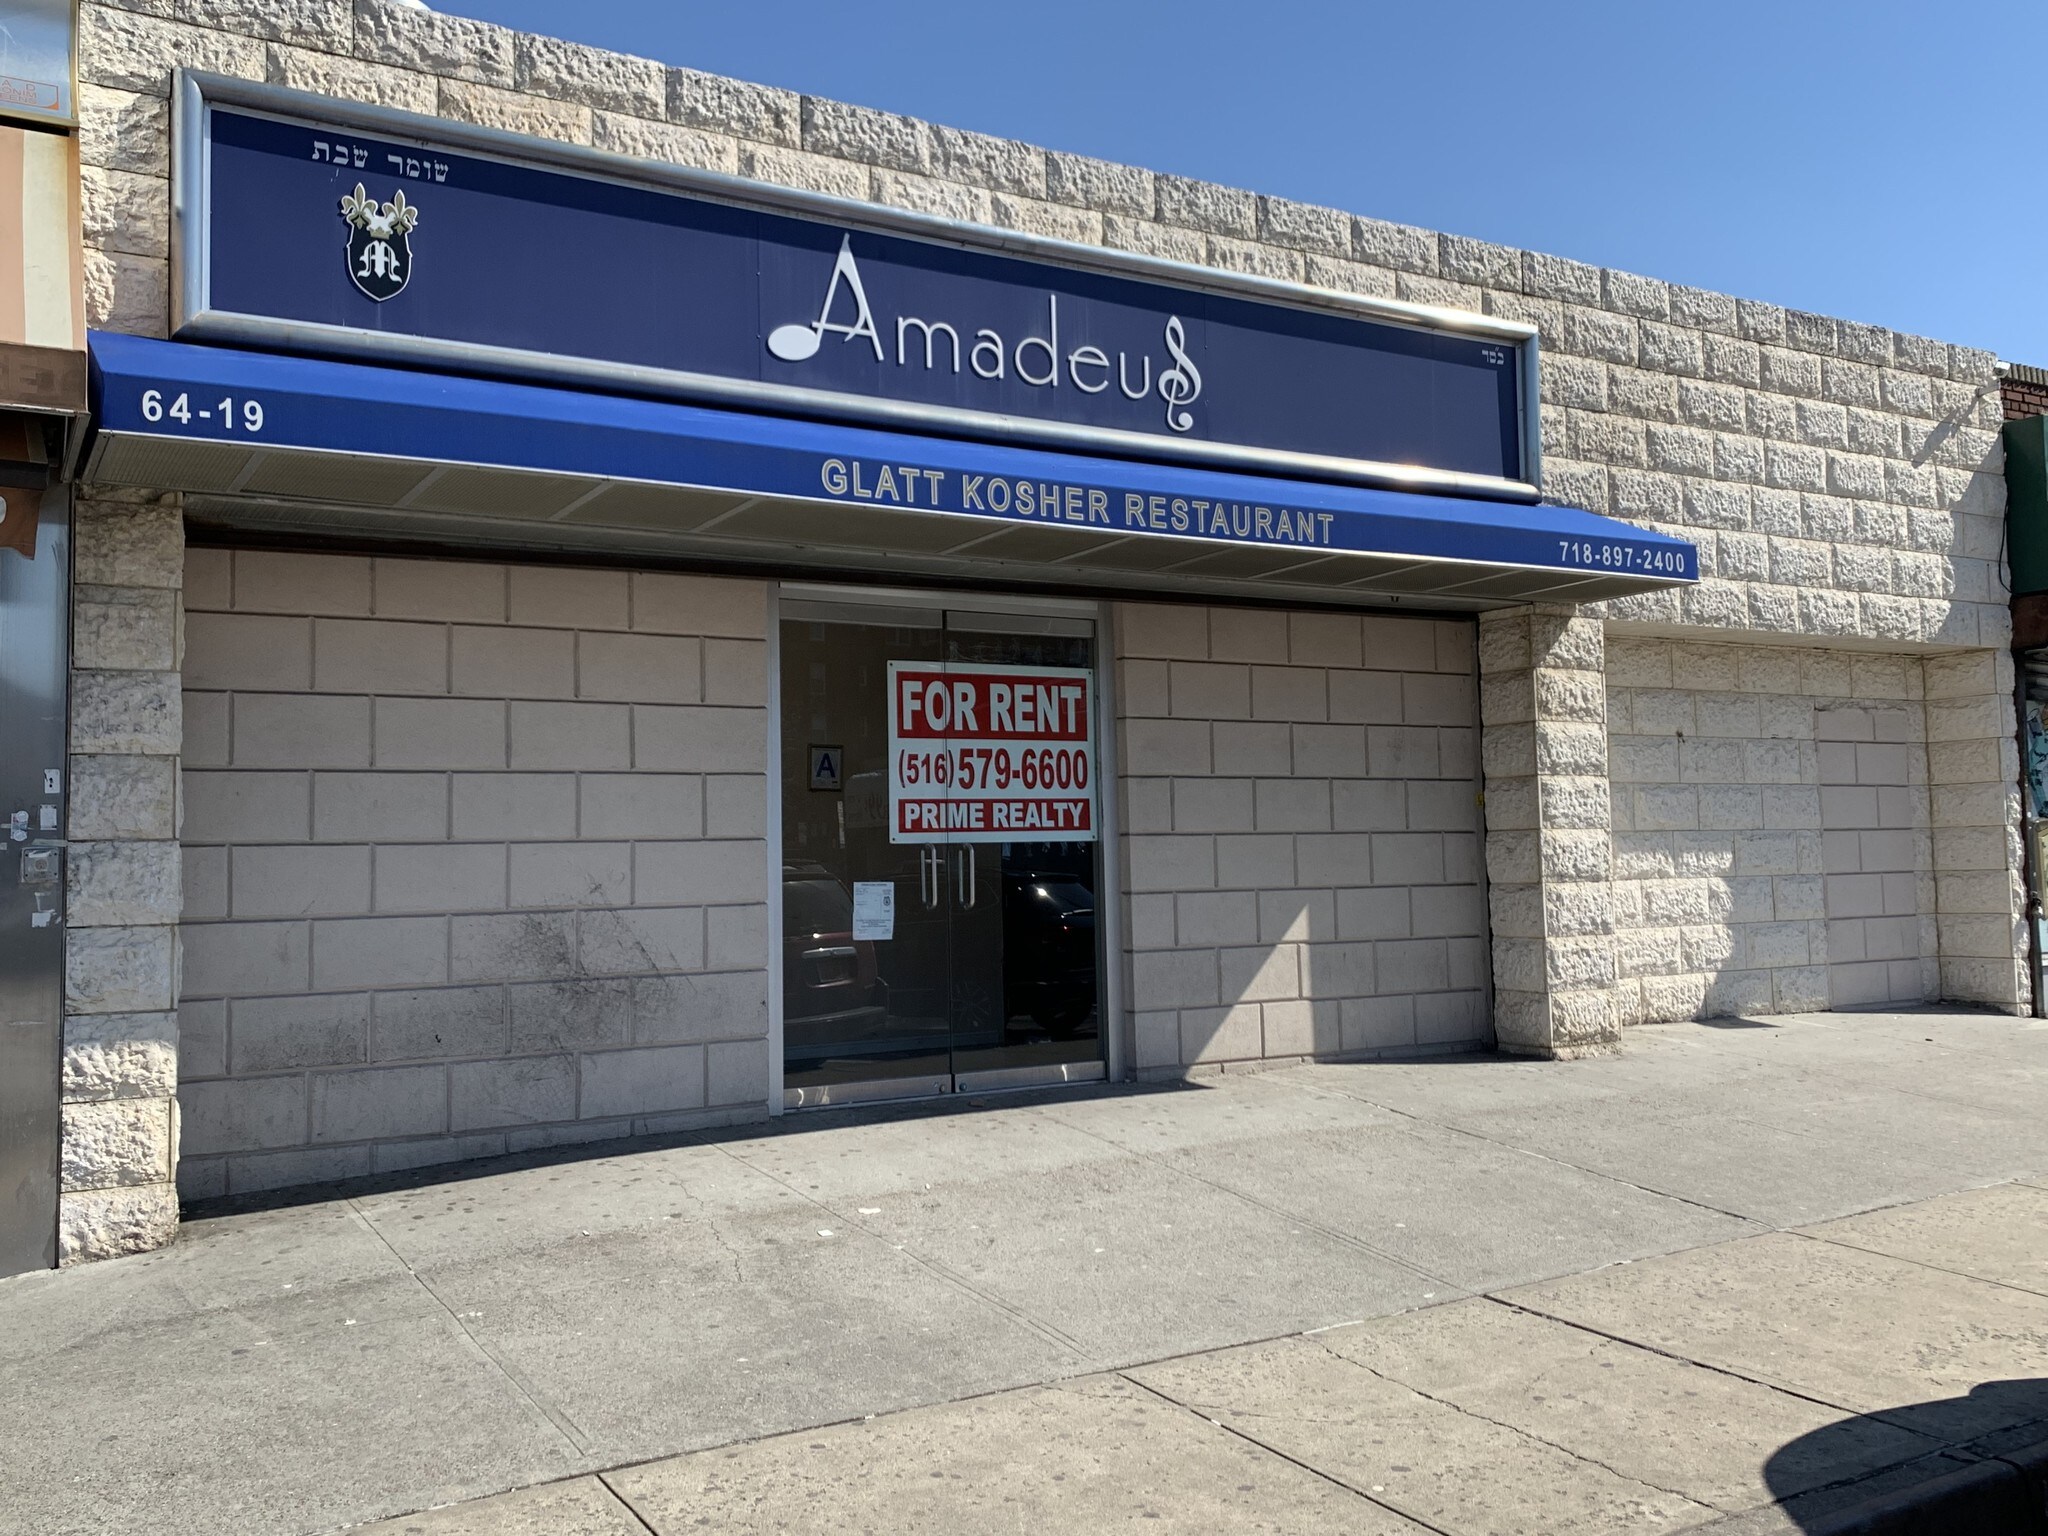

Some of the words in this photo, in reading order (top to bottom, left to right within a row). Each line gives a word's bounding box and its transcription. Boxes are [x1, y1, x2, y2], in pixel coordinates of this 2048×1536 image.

[142, 389, 264, 432] 64-19
[821, 458, 945, 506] GLATT
[962, 474, 1110, 524] KOSHER
[1125, 493, 1334, 544] RESTAURANT
[1559, 541, 1685, 573] 718-897-2400
[902, 680, 979, 731] FOR
[989, 682, 1082, 733] RENT
[816, 752, 836, 778] A
[904, 802, 985, 830] PRIME
[992, 802, 1084, 829] REALTY
